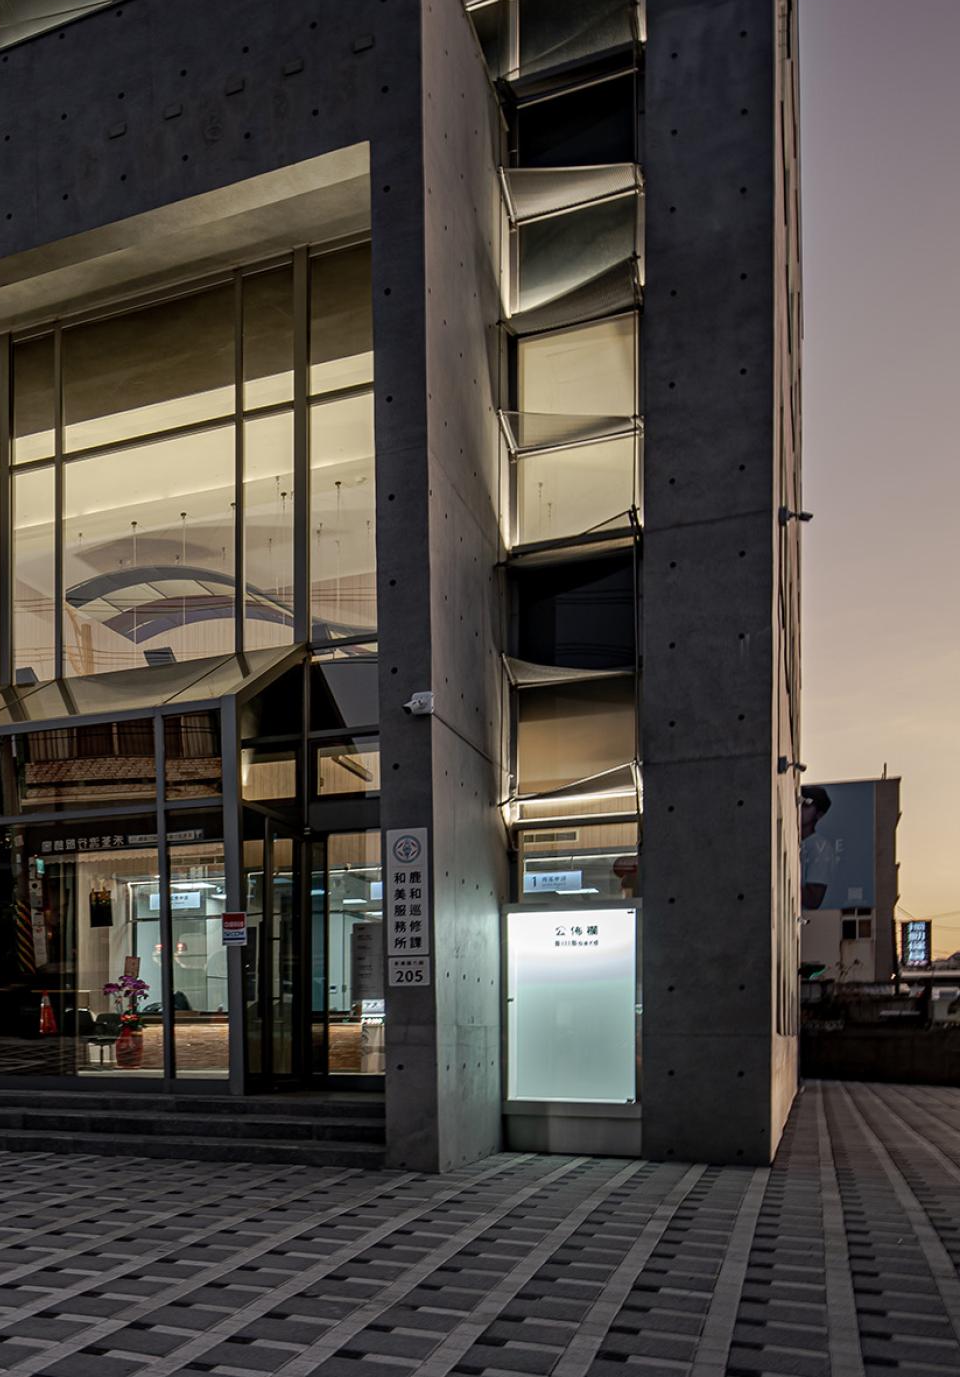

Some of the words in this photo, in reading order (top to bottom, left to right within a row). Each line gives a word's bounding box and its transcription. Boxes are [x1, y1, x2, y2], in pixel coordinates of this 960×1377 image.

[394, 872, 406, 950] 和美服務所
[395, 970, 424, 983] 205
